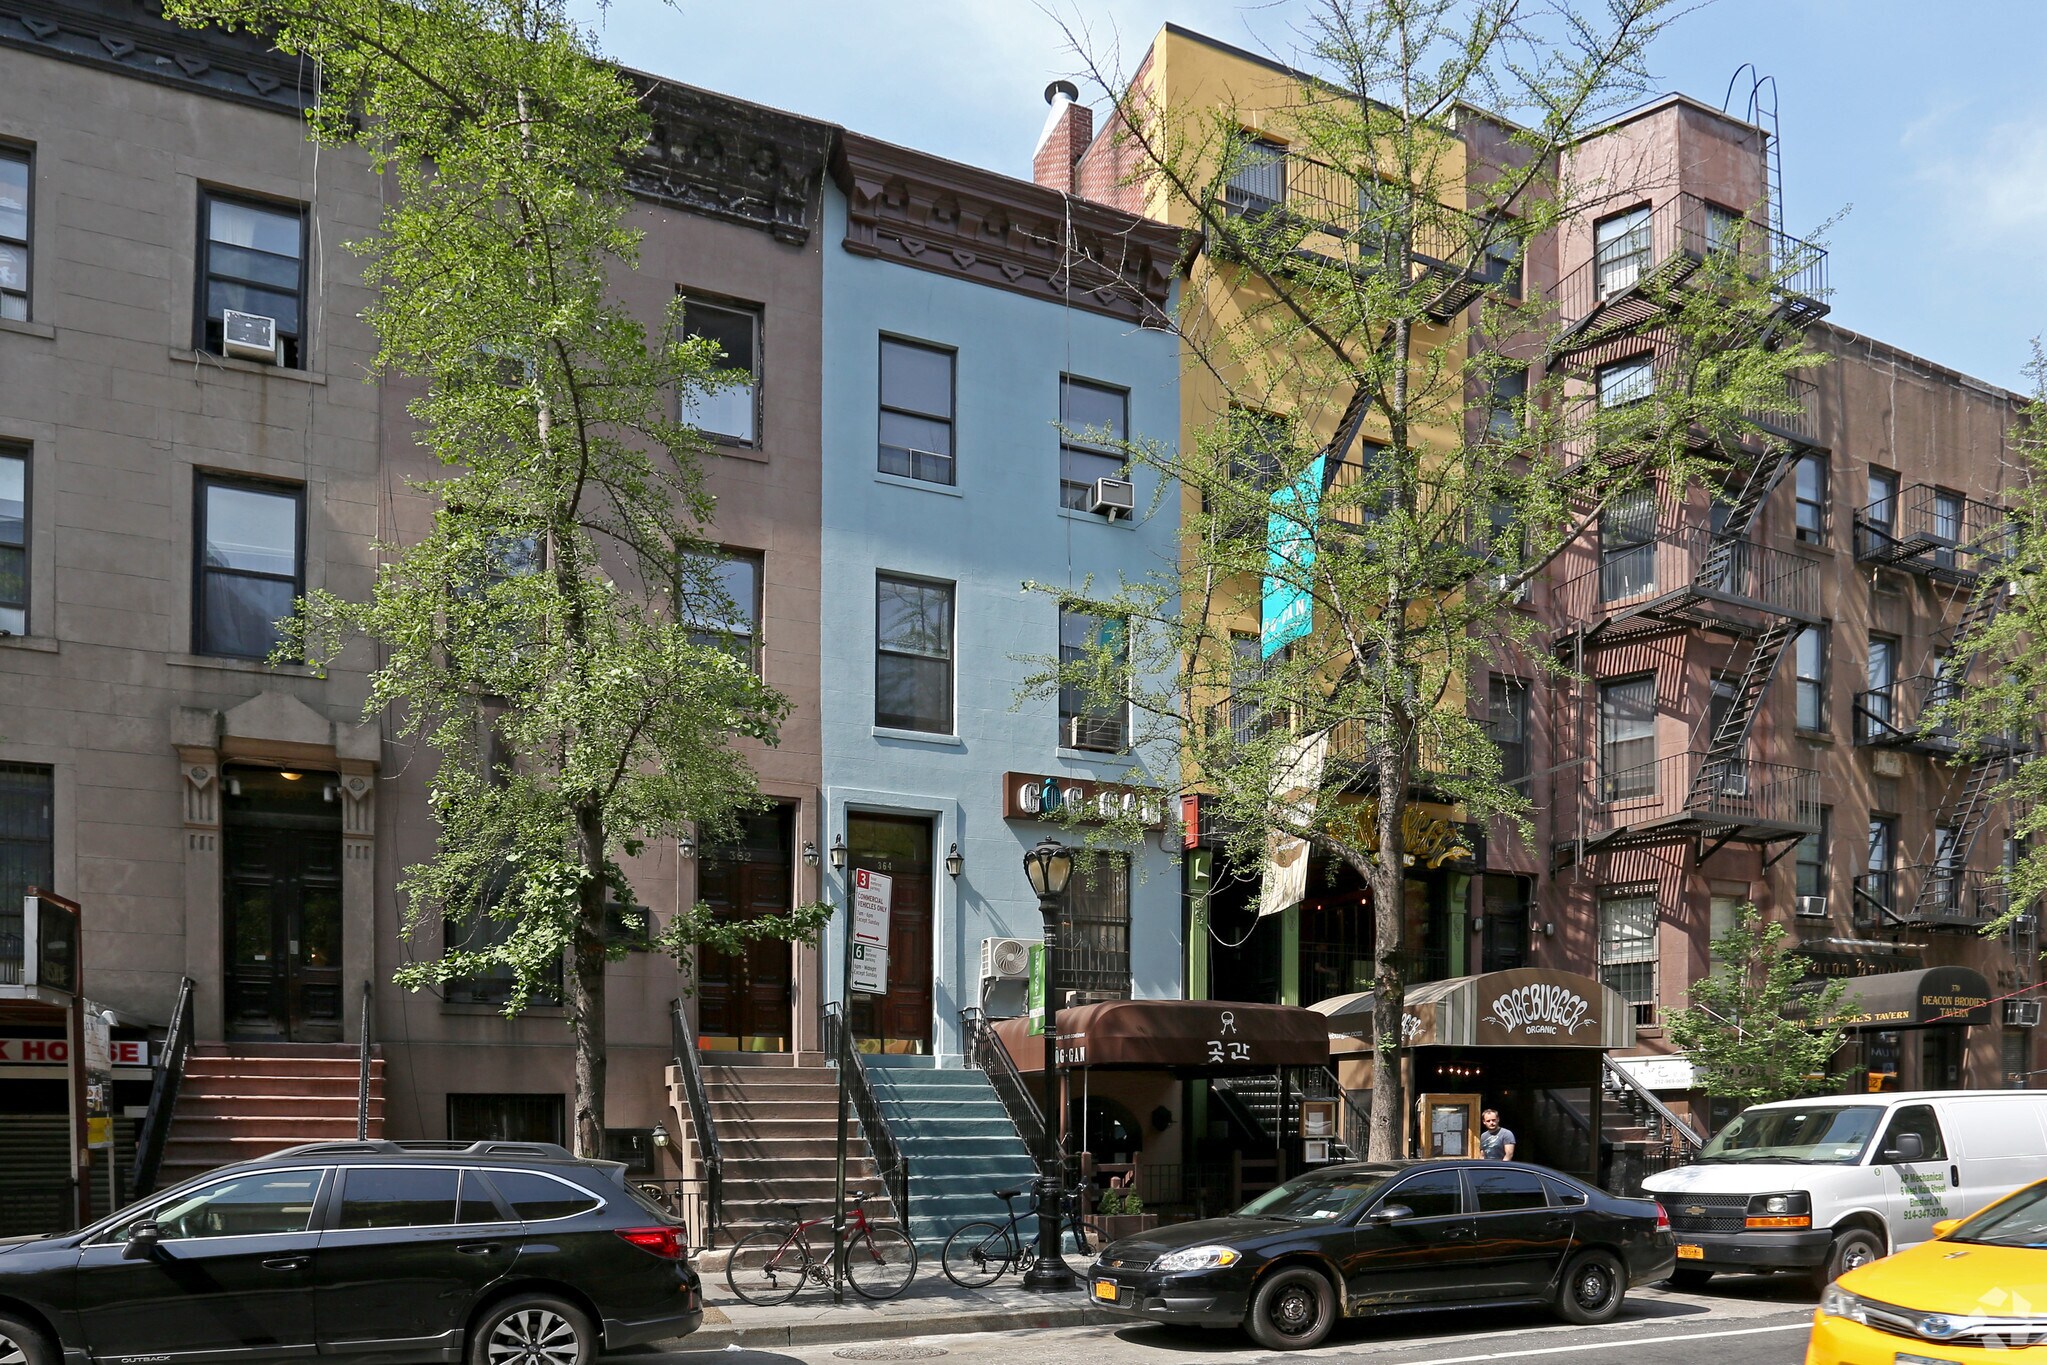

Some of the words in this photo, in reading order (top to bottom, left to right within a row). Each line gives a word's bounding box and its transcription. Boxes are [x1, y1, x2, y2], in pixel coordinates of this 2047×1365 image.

[729, 850, 752, 862] 362
[877, 861, 892, 871] 364
[860, 872, 867, 887] 3
[857, 892, 884, 905] COMMERCIAL
[857, 900, 877, 911] VEHICLES
[877, 904, 887, 913] ONLY
[856, 916, 868, 925] Except
[868, 918, 880, 927] Sunday
[855, 945, 862, 959] 6
[853, 969, 865, 978] Except
[865, 971, 878, 979] Sunday
[1922, 995, 1953, 1006] DEACON
[1492, 983, 1588, 1036] BAREBURGER
[1940, 1007, 1969, 1018] TAVERN
[1874, 1010, 1910, 1021] TAVERN
[1525, 1025, 1558, 1035] ORGANIC
[1206, 1040, 1251, 1064] 곳간
[1901, 1173, 1909, 1183] AP
[1910, 1172, 1945, 1182] Mechanical
[1905, 1186, 1918, 1195] West
[1918, 1185, 1930, 1195] Main
[1931, 1184, 1946, 1193] Street
[1903, 1207, 1949, 1220] 914-347-3700
[121, 1355, 171, 1364] OUTBACK
